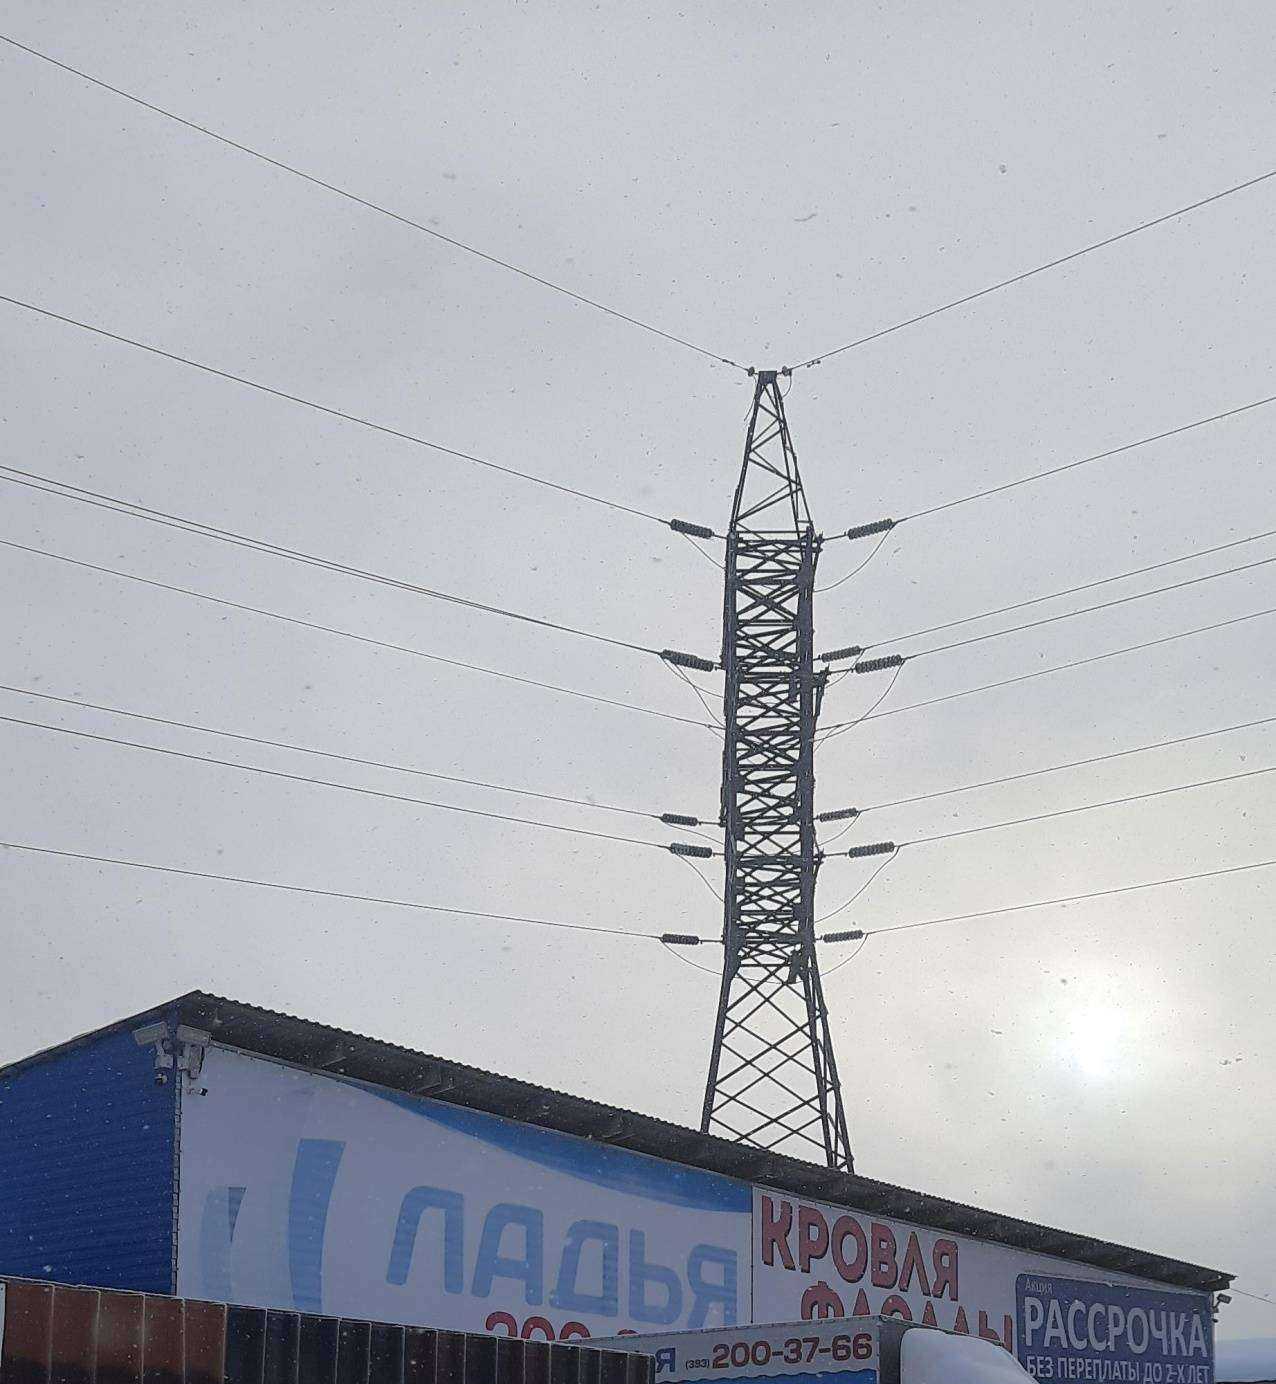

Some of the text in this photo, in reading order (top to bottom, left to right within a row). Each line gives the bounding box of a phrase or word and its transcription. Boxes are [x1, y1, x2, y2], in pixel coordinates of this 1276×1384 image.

[386, 1185, 738, 1328] ЛАДЬЯ
[760, 1195, 960, 1301] КРОВЛЯ
[712, 1333, 873, 1369] 200-37-66
[1024, 1297, 1208, 1358] РАССРОЧКА
[1026, 1355, 1053, 1378] БЕЗ
[1058, 1357, 1139, 1382] ПЕРЕПЛАТЫ
[1188, 1365, 1210, 1384] ЛЕТ
